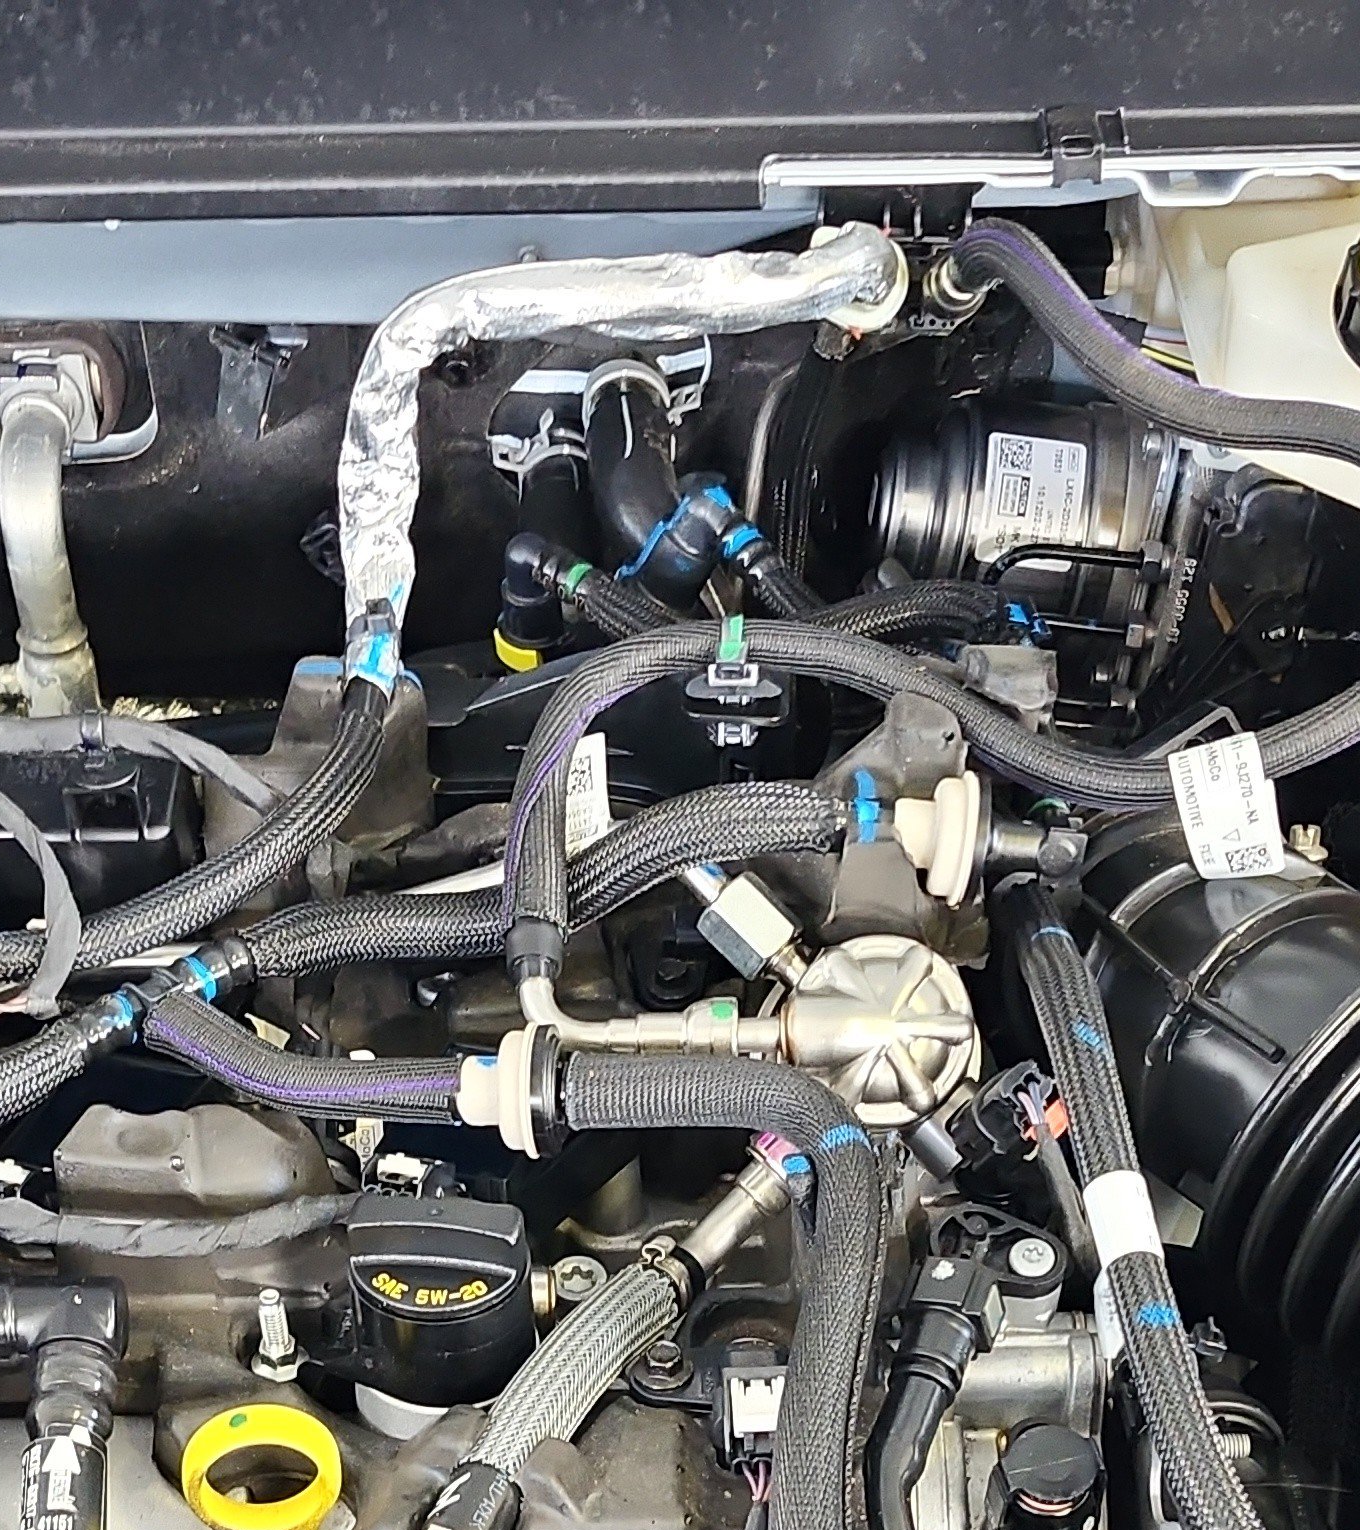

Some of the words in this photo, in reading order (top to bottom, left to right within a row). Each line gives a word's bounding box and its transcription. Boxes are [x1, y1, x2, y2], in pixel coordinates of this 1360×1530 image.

[1177, 755, 1204, 830] AUTOMOTIVE
[371, 1272, 409, 1300] SAE
[414, 1280, 489, 1306] 5W-20
